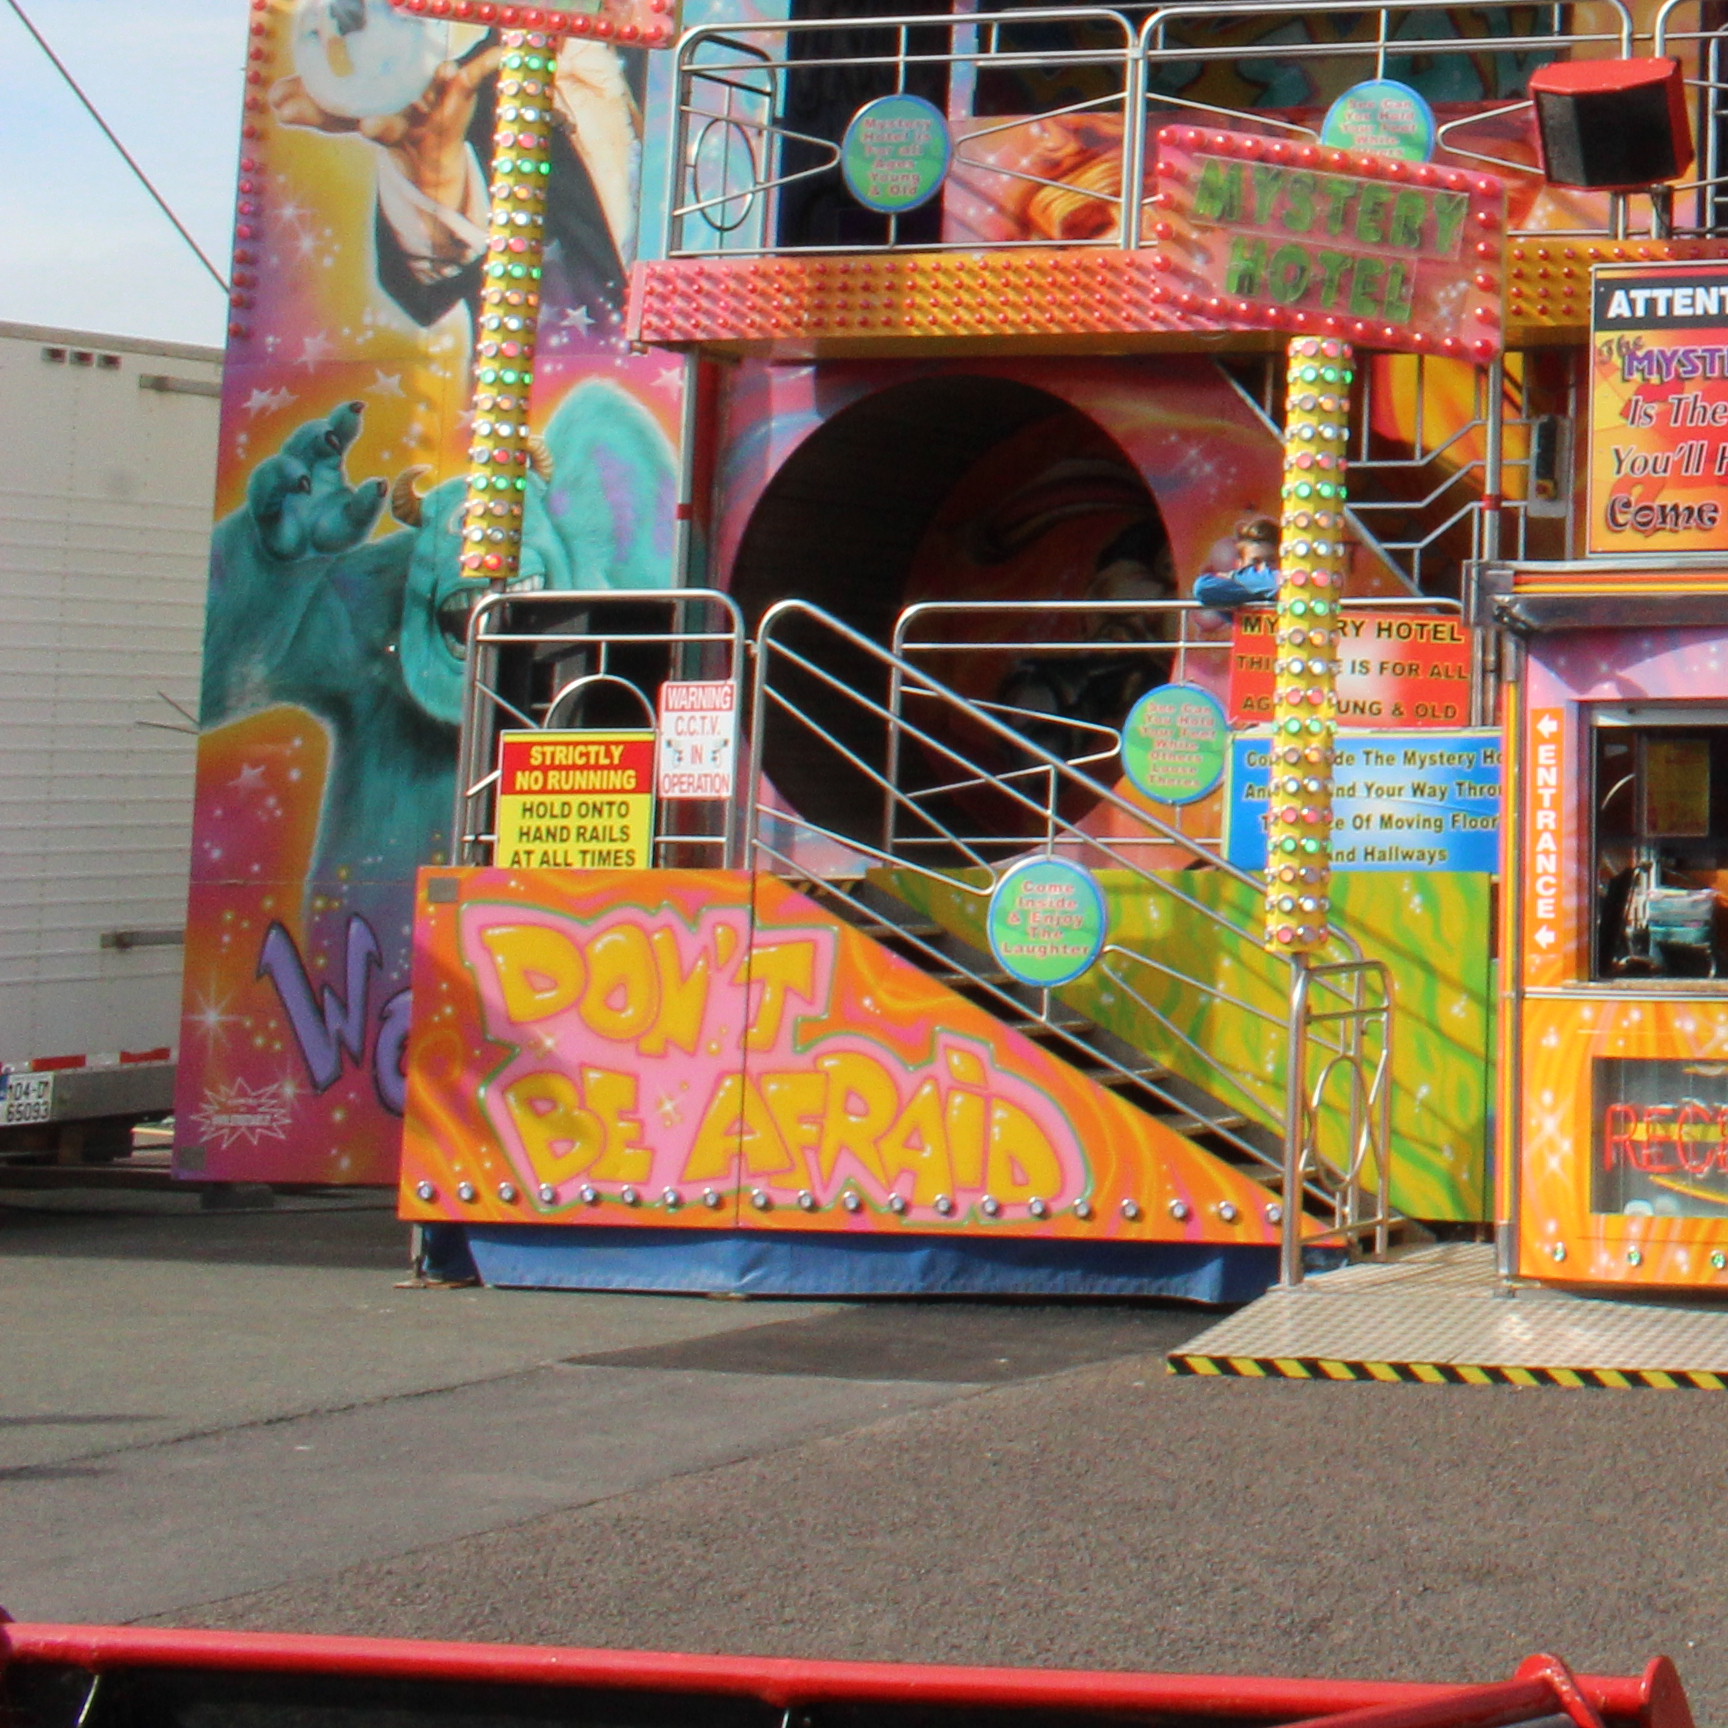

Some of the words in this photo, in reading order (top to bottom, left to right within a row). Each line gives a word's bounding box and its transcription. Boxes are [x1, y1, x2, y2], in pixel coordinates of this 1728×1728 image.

[1193, 158, 1468, 254] MYSTERY
[1225, 237, 1412, 323] HOTEL
[1599, 334, 1645, 364] The
[1628, 395, 1656, 426] Is
[1668, 393, 1728, 425] The
[1612, 441, 1708, 477] You'll
[1606, 495, 1720, 530] Come
[1376, 622, 1465, 643] HOTEL
[1350, 660, 1370, 674] IS
[1379, 661, 1420, 678] FOR
[1429, 664, 1469, 680] ALL
[667, 686, 732, 710] WARNING
[1390, 702, 1405, 717] &
[1414, 703, 1458, 720] OLD
[675, 716, 721, 737] C.C.T.V.
[530, 745, 625, 766] STRICTLY
[690, 744, 703, 764] IN
[1362, 750, 1396, 766] The
[1402, 750, 1477, 770] Mystery
[515, 770, 544, 791] NO
[547, 769, 637, 790] RUNNING
[662, 774, 730, 794] OPERATION
[1364, 782, 1406, 799] Your
[1411, 782, 1449, 801] Way
[521, 801, 572, 819] HOLD
[577, 801, 631, 819] ONTO
[1352, 813, 1375, 831] Of
[1379, 813, 1444, 833] Moving
[1535, 743, 1557, 920] ENTRANCE
[518, 825, 571, 843] HAND
[576, 825, 631, 843] RAILS
[510, 850, 535, 868] AT
[539, 850, 573, 868] ALL
[579, 849, 636, 868] TIMES
[1363, 846, 1449, 864] Hallways
[1022, 880, 1076, 894] Come
[1016, 895, 1079, 909] Inside
[1029, 912, 1085, 929] Enjoy
[1026, 927, 1065, 940] The
[1001, 941, 1092, 960] Laughter
[478, 920, 817, 1060] DON'T
[501, 1064, 655, 1188] BE
